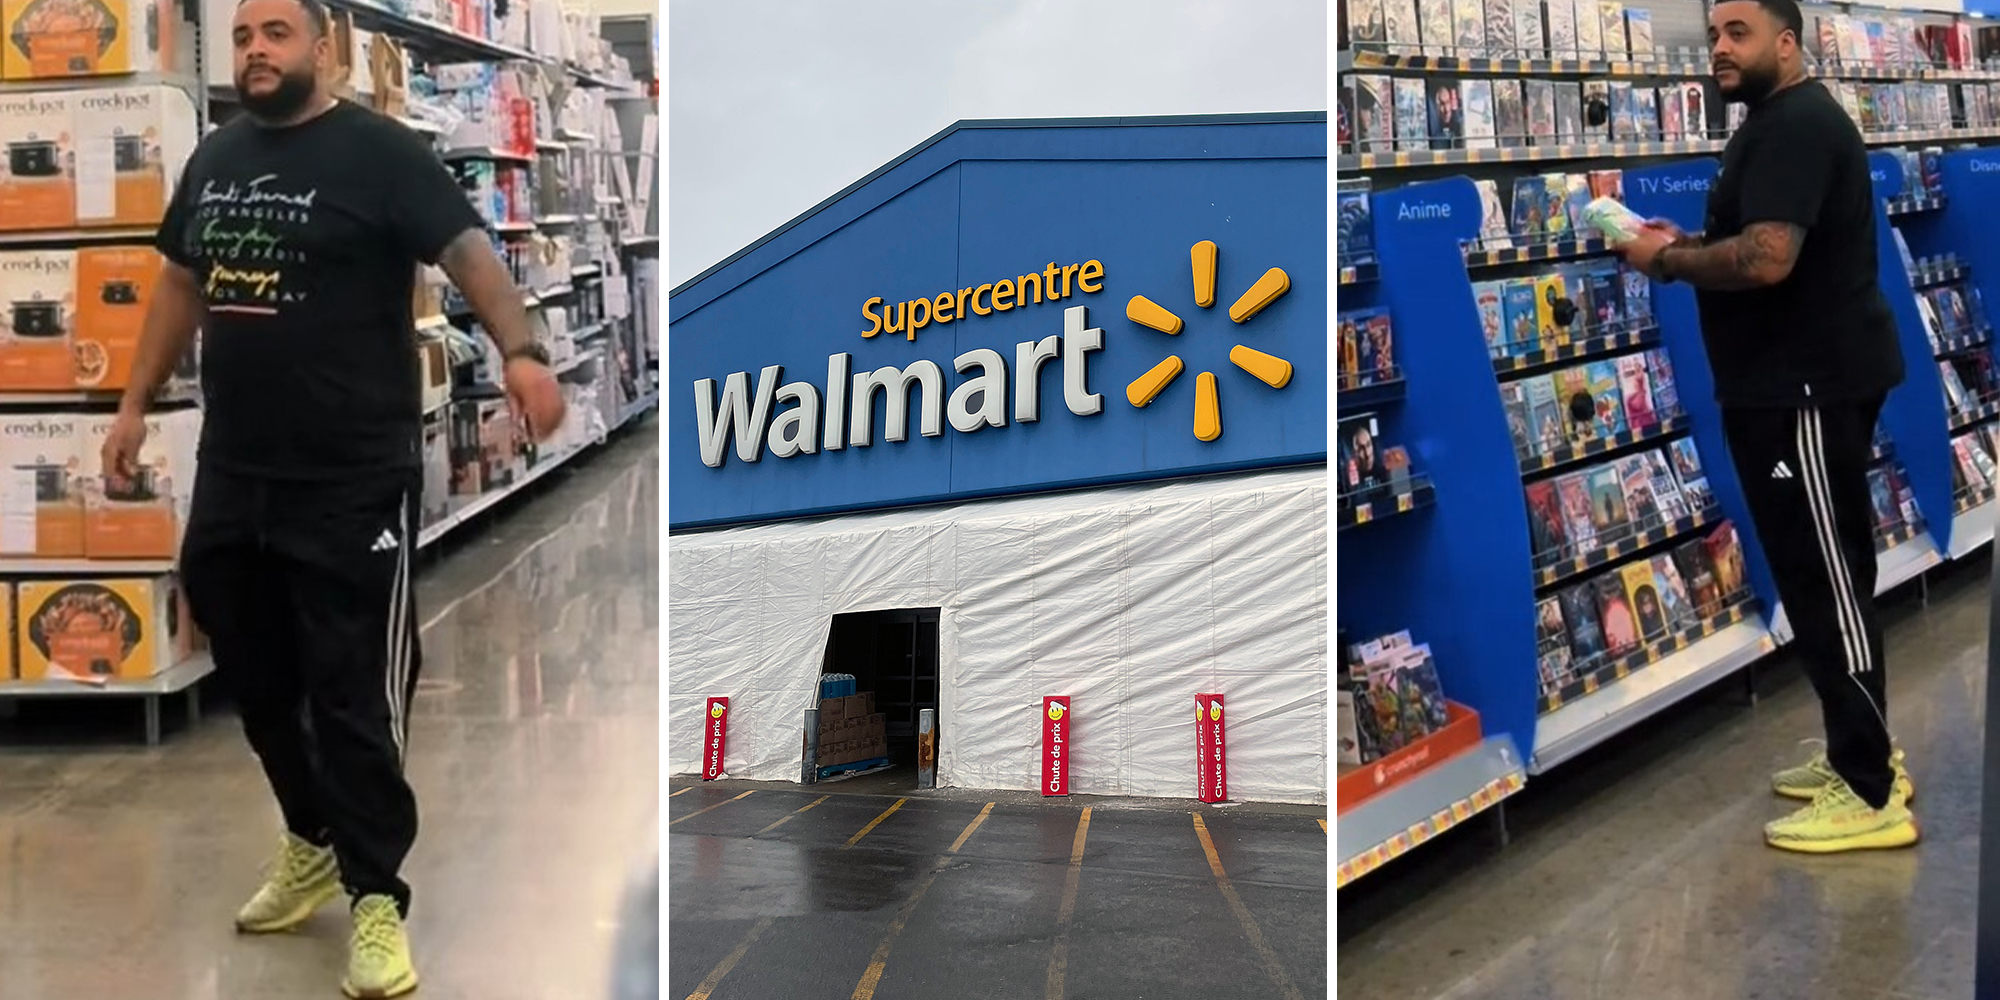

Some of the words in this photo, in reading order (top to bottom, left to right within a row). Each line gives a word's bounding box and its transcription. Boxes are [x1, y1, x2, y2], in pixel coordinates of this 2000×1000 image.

[1638, 177, 1659, 194] TV
[1662, 175, 1710, 193] Series
[1397, 200, 1451, 220] Anime
[861, 258, 1105, 341] Supercentre
[694, 305, 1105, 468] Walmart
[713, 720, 721, 737] prix
[1051, 723, 1063, 743] prix
[1213, 724, 1222, 745] prix
[711, 738, 719, 749] de
[1051, 745, 1060, 758] de
[709, 750, 718, 777] Chute
[1214, 747, 1221, 761] de
[1050, 760, 1060, 792] Chute
